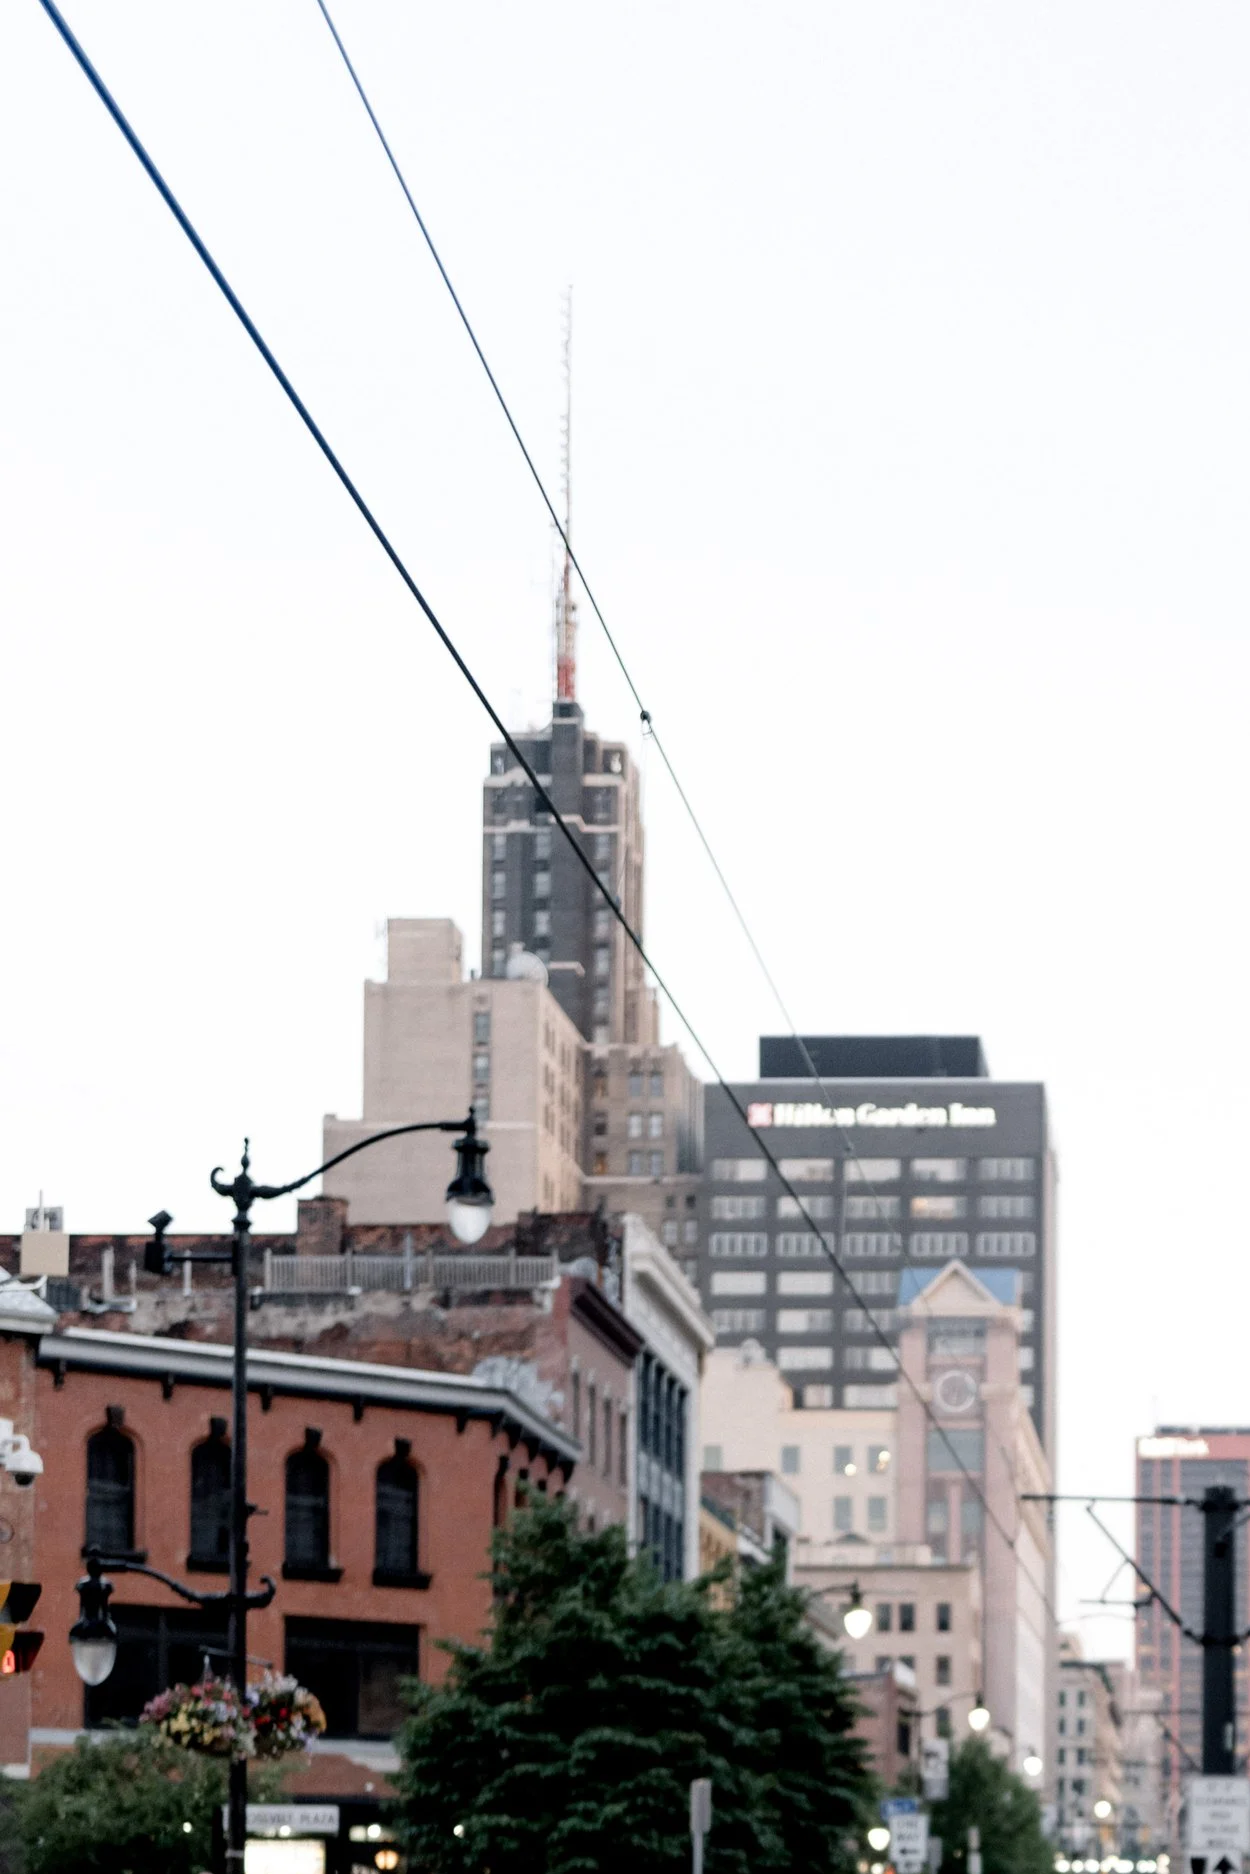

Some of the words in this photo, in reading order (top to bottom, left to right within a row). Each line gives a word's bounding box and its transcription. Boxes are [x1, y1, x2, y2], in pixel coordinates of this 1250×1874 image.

[774, 1102, 855, 1128] Hilton
[856, 1103, 948, 1128] Garden
[949, 1103, 996, 1128] Inn
[300, 1814, 335, 1824] PLAZA
